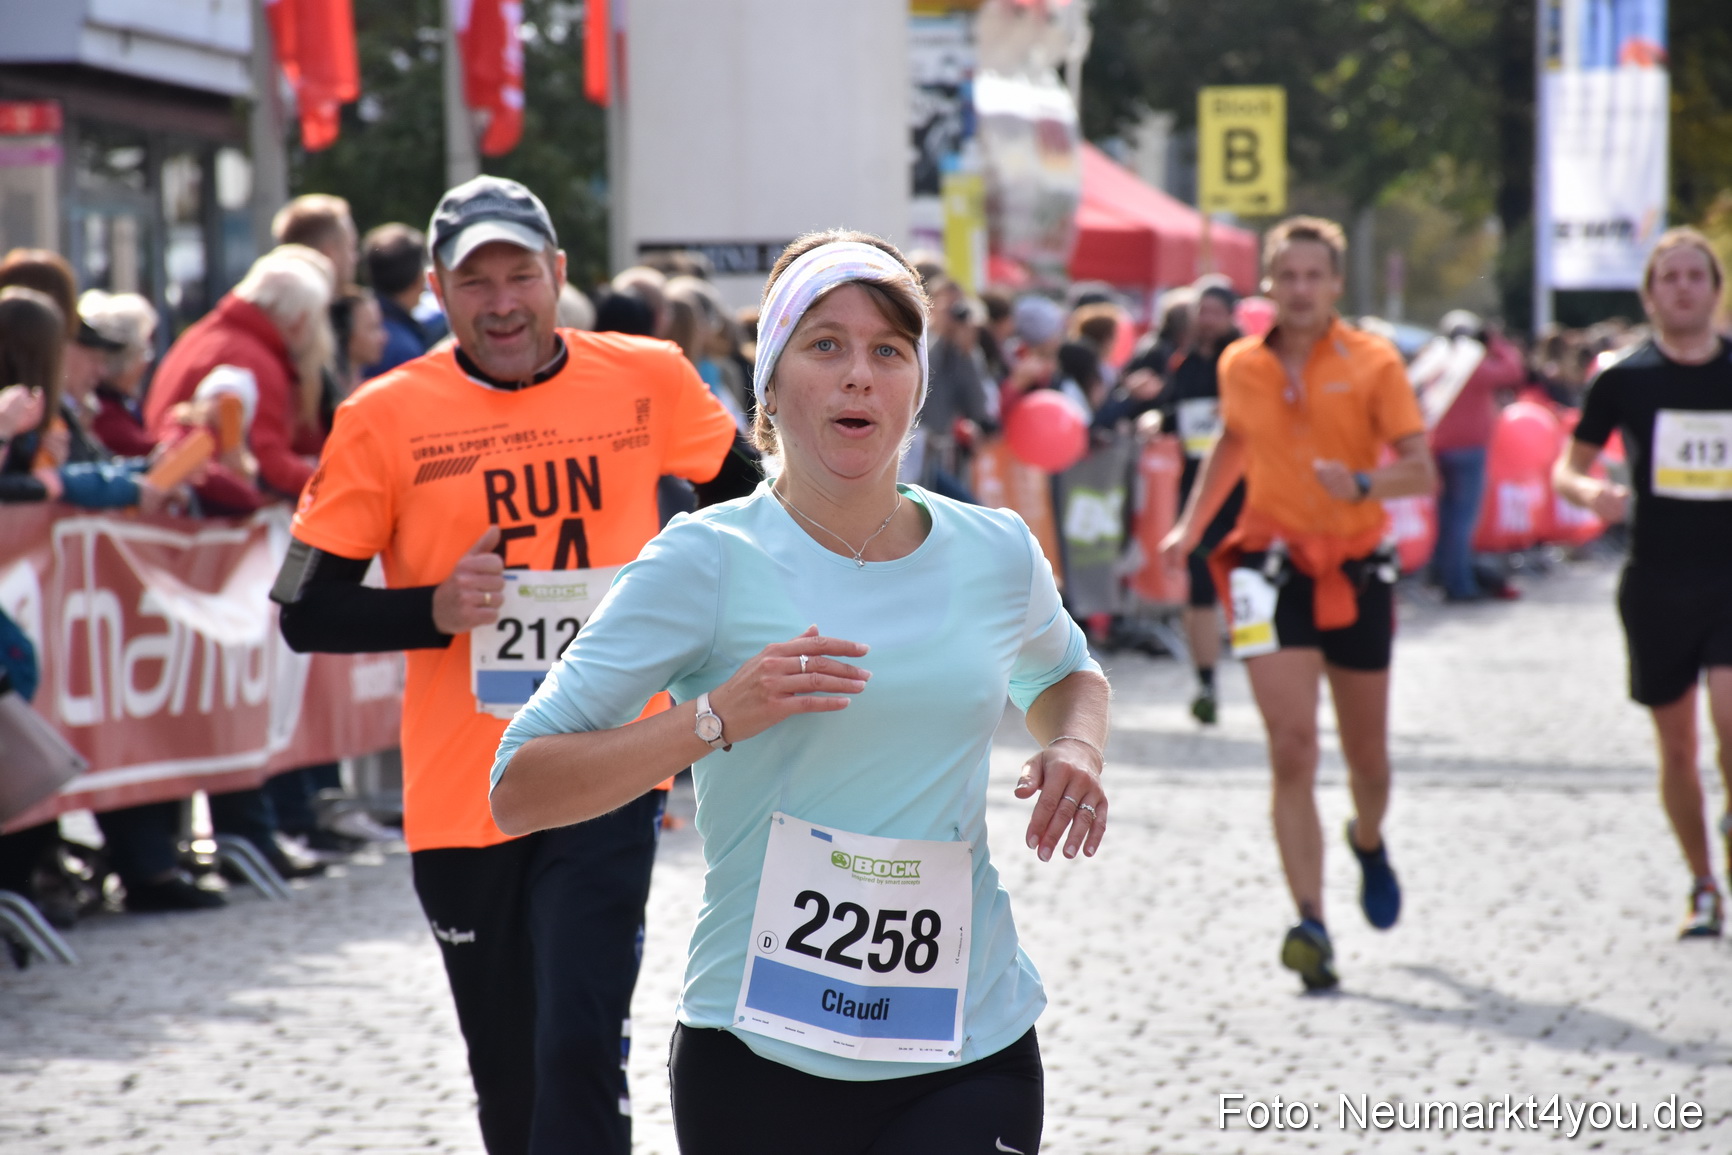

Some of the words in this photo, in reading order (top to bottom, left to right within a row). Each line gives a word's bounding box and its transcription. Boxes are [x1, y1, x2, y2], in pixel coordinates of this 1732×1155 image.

[1223, 129, 1260, 183] B
[412, 444, 455, 461] URBAN
[458, 436, 497, 453] SPORT
[501, 429, 538, 444] VIBES
[1676, 439, 1726, 466] 413
[483, 455, 603, 522] RUN
[534, 583, 588, 598] BOCK
[496, 616, 591, 661] 212
[852, 873, 875, 884] inspired
[901, 879, 921, 887] concepts
[853, 855, 921, 878] BOCK
[763, 936, 772, 949] D
[785, 889, 942, 974] 2258
[821, 988, 890, 1021] Claudi
